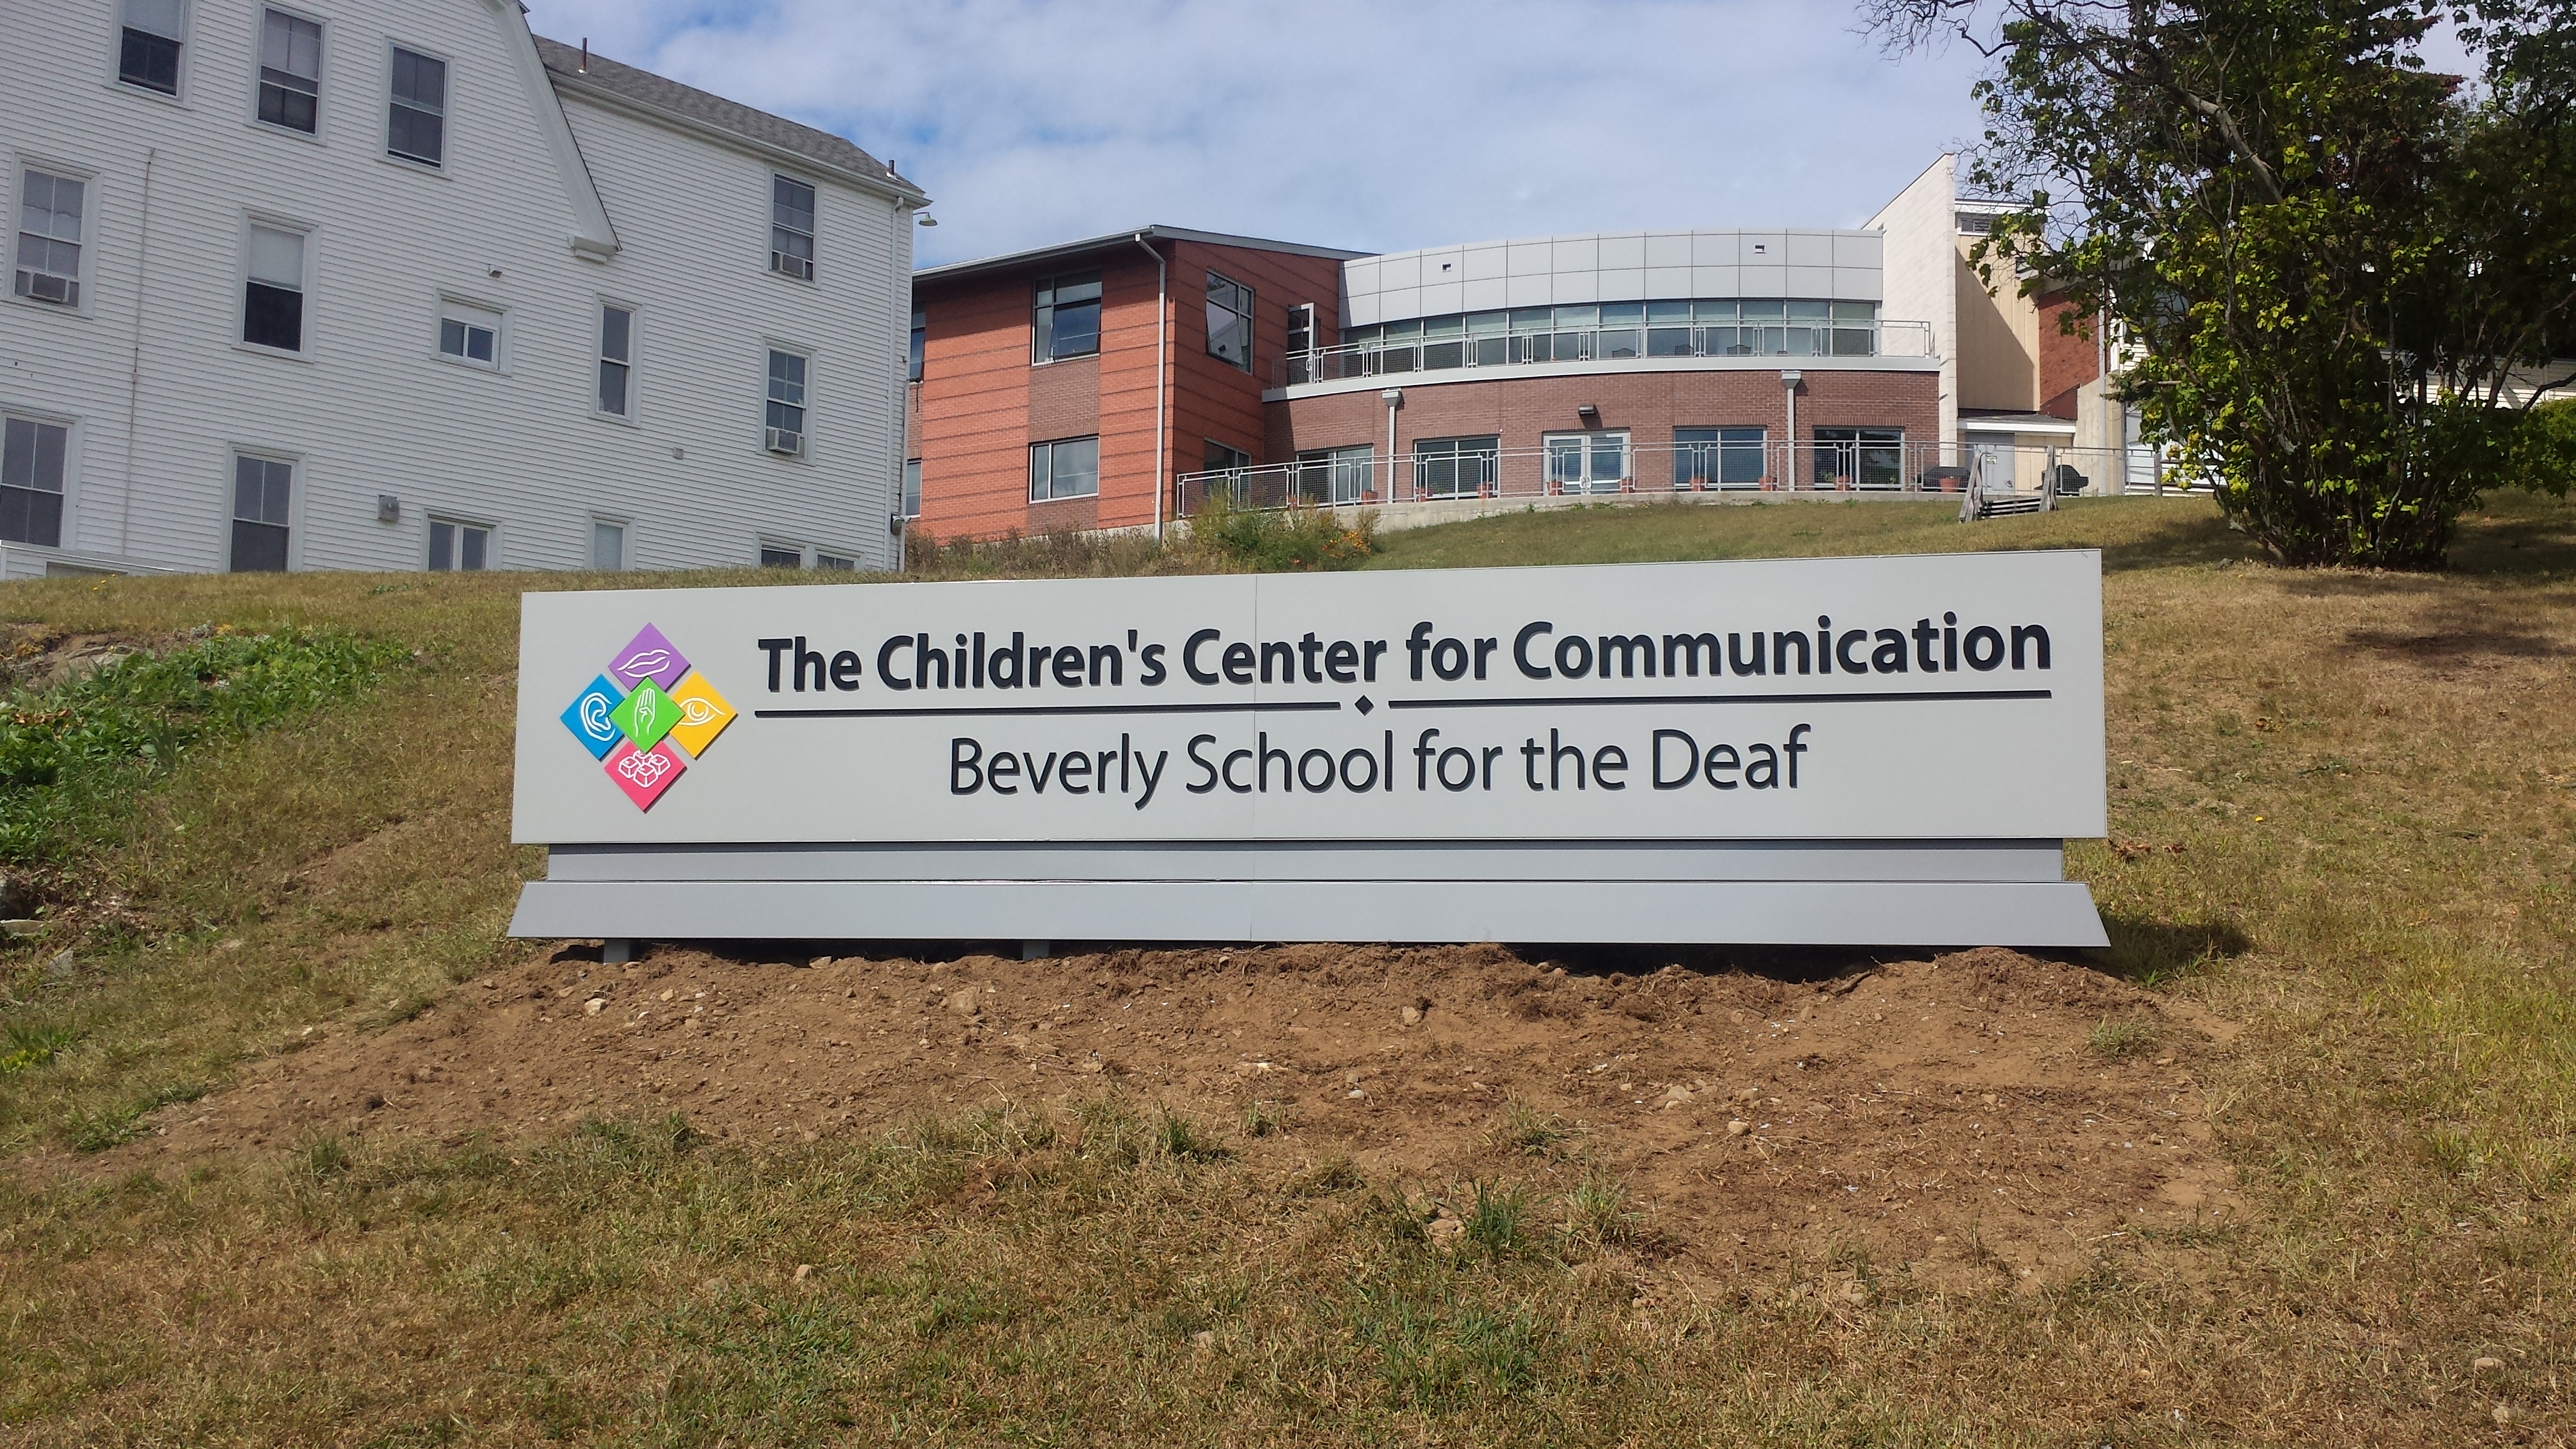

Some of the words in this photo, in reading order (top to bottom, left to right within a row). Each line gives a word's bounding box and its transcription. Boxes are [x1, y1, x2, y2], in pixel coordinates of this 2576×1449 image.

[758, 637, 861, 692] The
[877, 629, 1166, 690] Children's
[1183, 629, 1387, 686] Center
[1406, 621, 1497, 681] for
[1514, 612, 2051, 680] Communication
[951, 732, 1168, 811] Beverly
[1186, 729, 1392, 794] School
[1413, 728, 1503, 791] for
[1520, 728, 1627, 792] the
[1653, 724, 1811, 791] Deaf
